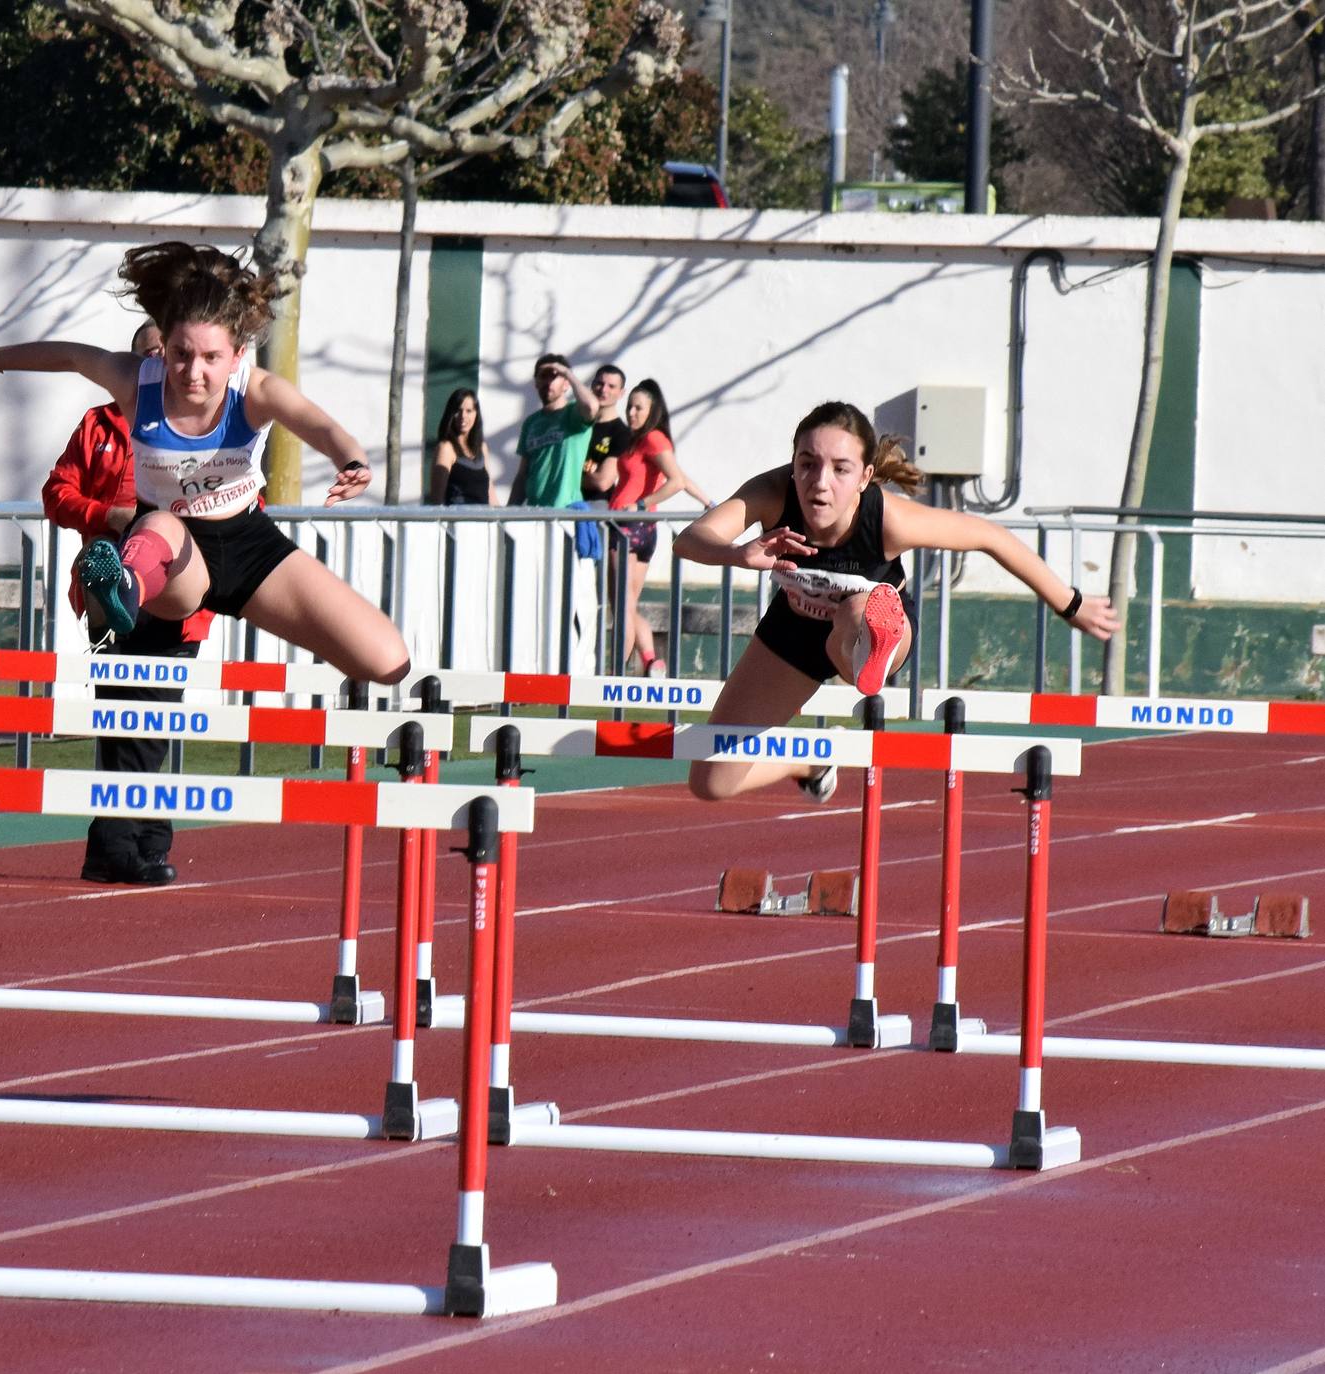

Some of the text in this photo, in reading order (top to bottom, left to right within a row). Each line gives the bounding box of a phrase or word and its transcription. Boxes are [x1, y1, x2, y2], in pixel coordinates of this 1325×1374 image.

[212, 458, 224, 467] La
[89, 662, 189, 684] MONDO
[603, 684, 703, 705] MONDO
[92, 709, 209, 734] MONDO
[1131, 705, 1234, 726] MONDO
[713, 733, 833, 759] MONDO
[90, 783, 234, 813] MONDO
